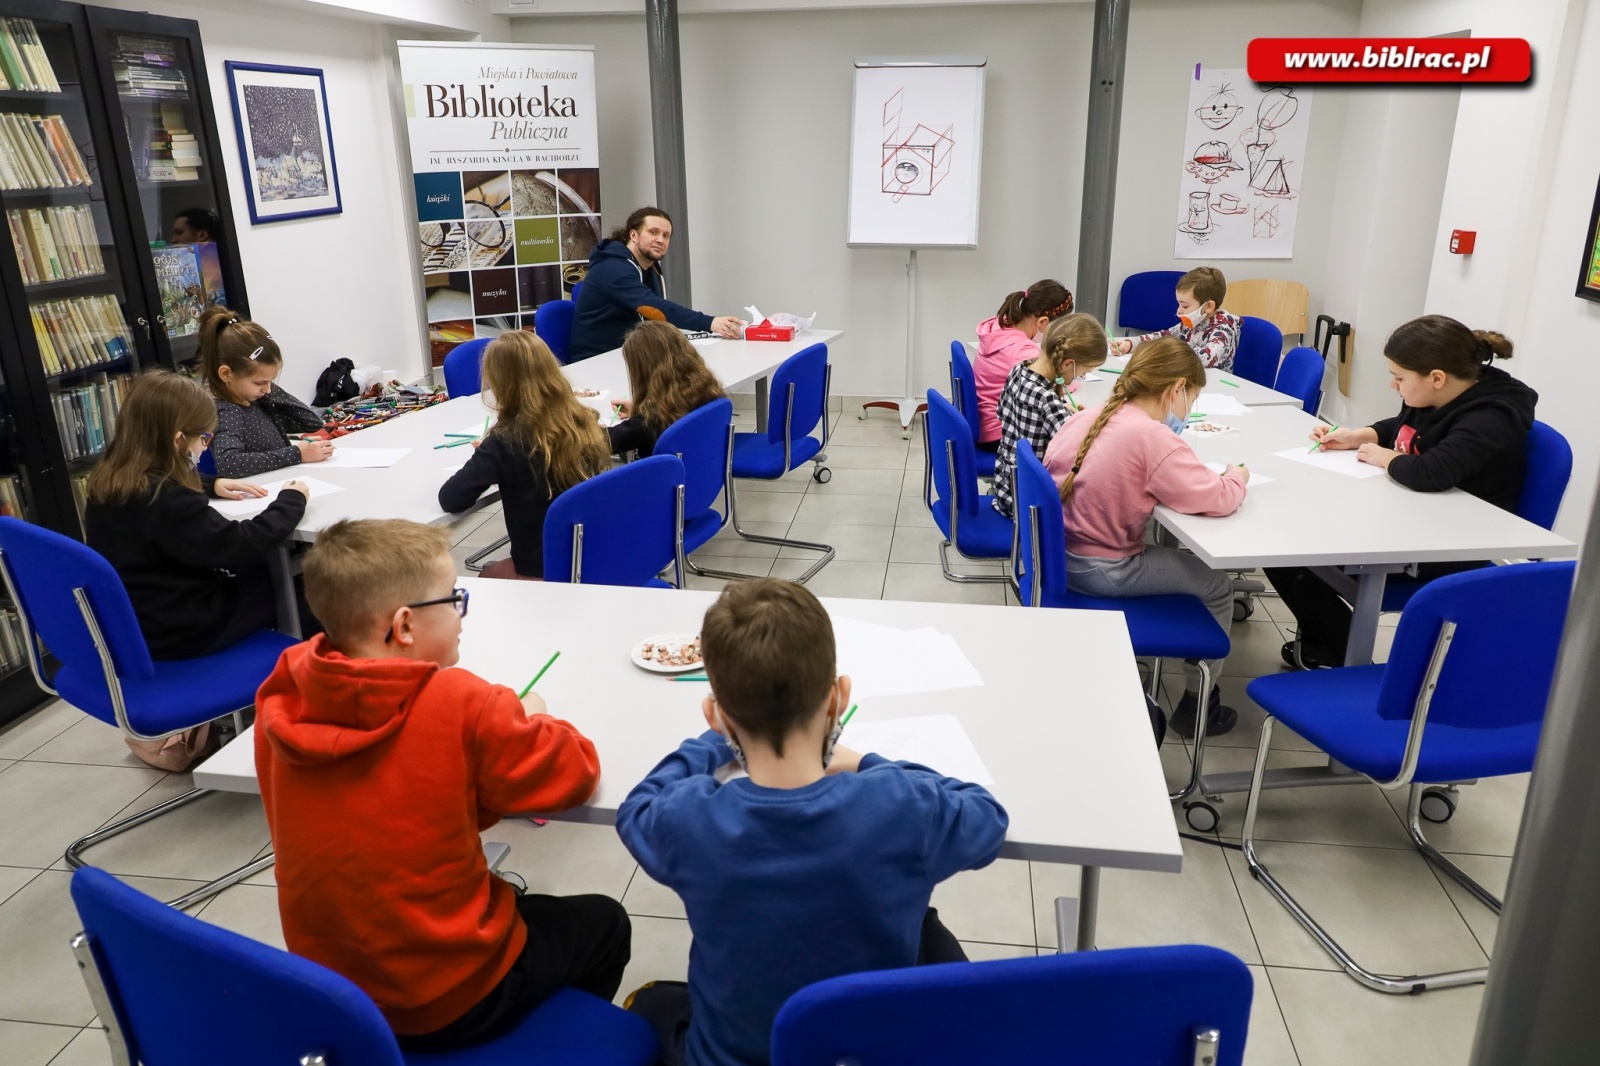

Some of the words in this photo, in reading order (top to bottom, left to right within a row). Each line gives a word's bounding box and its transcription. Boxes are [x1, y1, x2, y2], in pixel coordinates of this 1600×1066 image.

[478, 66, 517, 83] Miejska
[519, 67, 523, 80] i
[525, 67, 578, 80] Powiatowa
[423, 83, 579, 118] Biblioteka
[489, 121, 568, 142] Publiczna
[430, 157, 443, 165] IM.
[446, 156, 491, 164] RYSZARDA
[492, 155, 524, 163] KINCLA
[525, 155, 533, 163] W
[535, 154, 582, 162] RACIBORZU
[520, 237, 554, 246] multimedia
[156, 265, 192, 277] MELOT
[482, 289, 507, 298] muzyka
